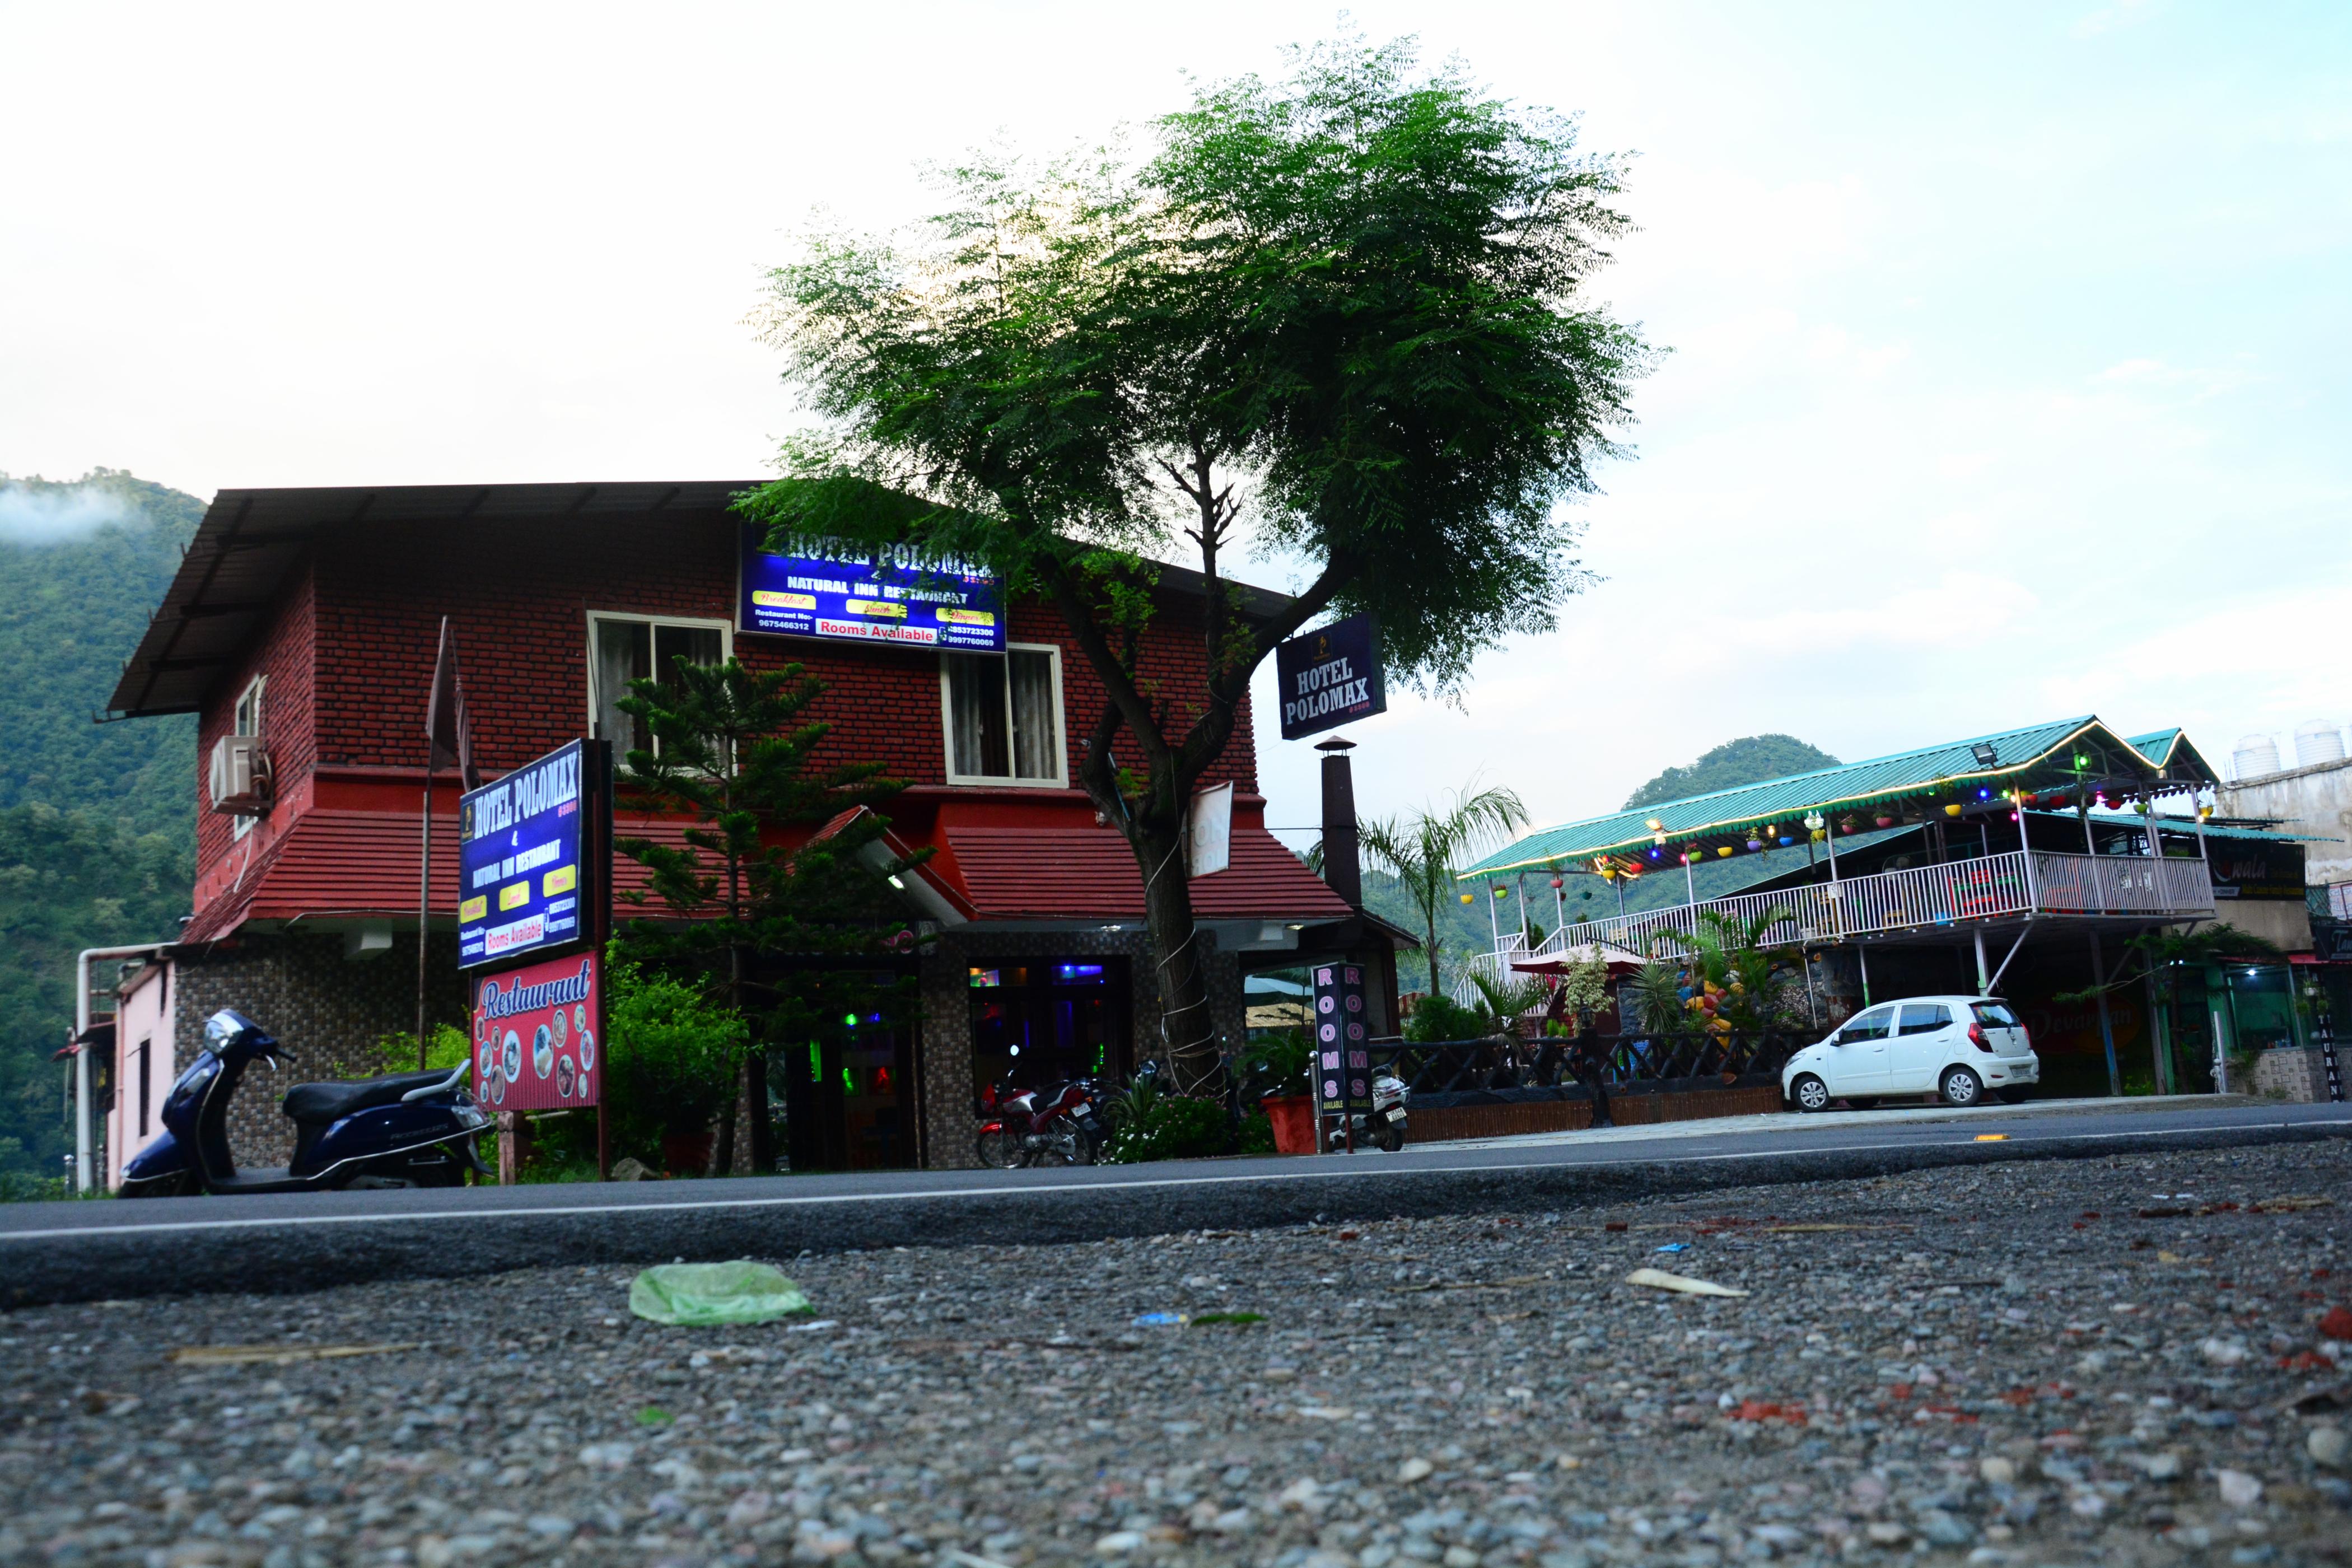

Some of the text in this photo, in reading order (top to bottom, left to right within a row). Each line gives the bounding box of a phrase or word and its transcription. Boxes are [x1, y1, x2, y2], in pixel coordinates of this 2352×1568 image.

[761, 592, 807, 605] Breakfast
[787, 576, 850, 594] NATURAL
[854, 582, 878, 597] INN
[755, 609, 796, 619] Restaurant
[758, 619, 809, 631] 9675466312
[820, 621, 933, 641] Rooms Available
[1296, 657, 1352, 696] HOTEL
[1286, 677, 1369, 725] POLOMAX
[474, 751, 577, 839] HOTEL POLOMAX
[488, 932, 509, 951] Rooms
[511, 920, 542, 945] Available
[483, 959, 591, 1020] Restaurant
[1318, 968, 1340, 1098] ROOMS
[1345, 967, 1368, 1097] ROOMS
